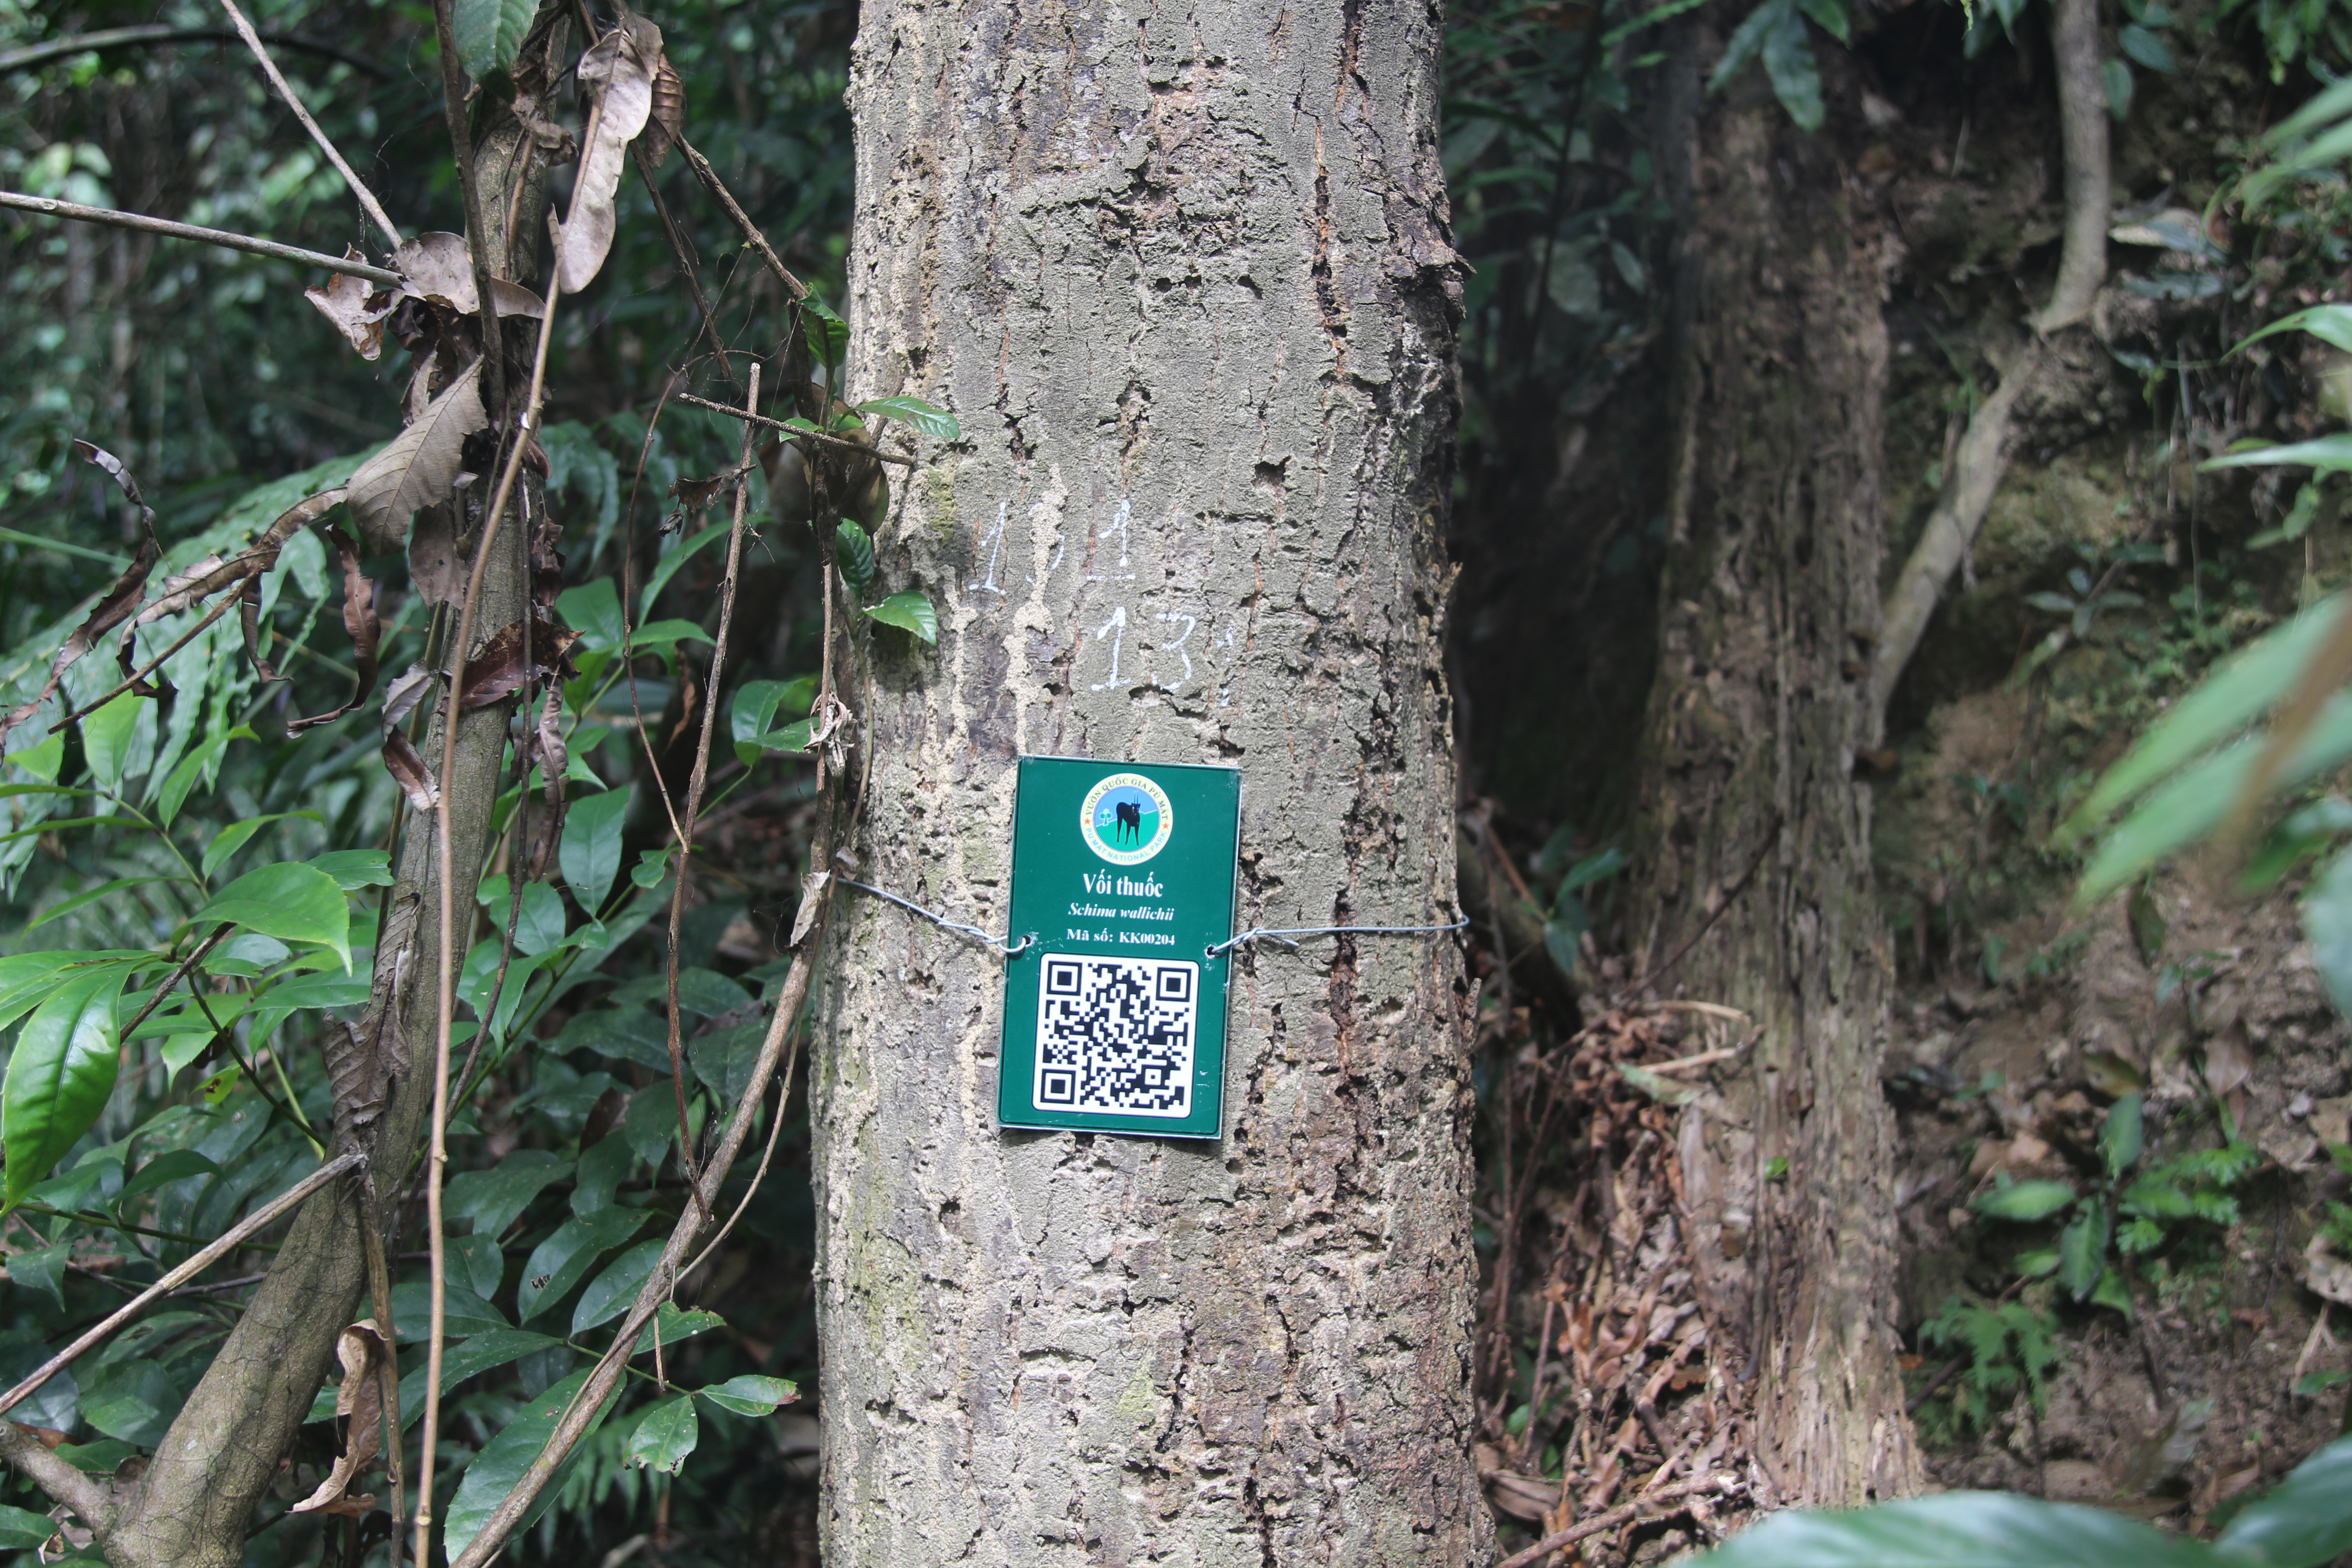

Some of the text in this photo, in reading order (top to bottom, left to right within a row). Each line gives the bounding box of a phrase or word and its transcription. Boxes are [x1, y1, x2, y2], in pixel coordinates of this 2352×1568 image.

[1086, 790, 1102, 815] VƯỜN
[1102, 776, 1128, 792] QUỐC
[1131, 779, 1147, 789] GIA
[1148, 787, 1161, 799] PÙ
[1086, 828, 1167, 861] PU MAT NATIONAL PARK
[1083, 868, 1164, 897] Vối thuốc
[1068, 902, 1175, 921] Schima wallichii
[1067, 927, 1176, 946] Mã số: KK00204
